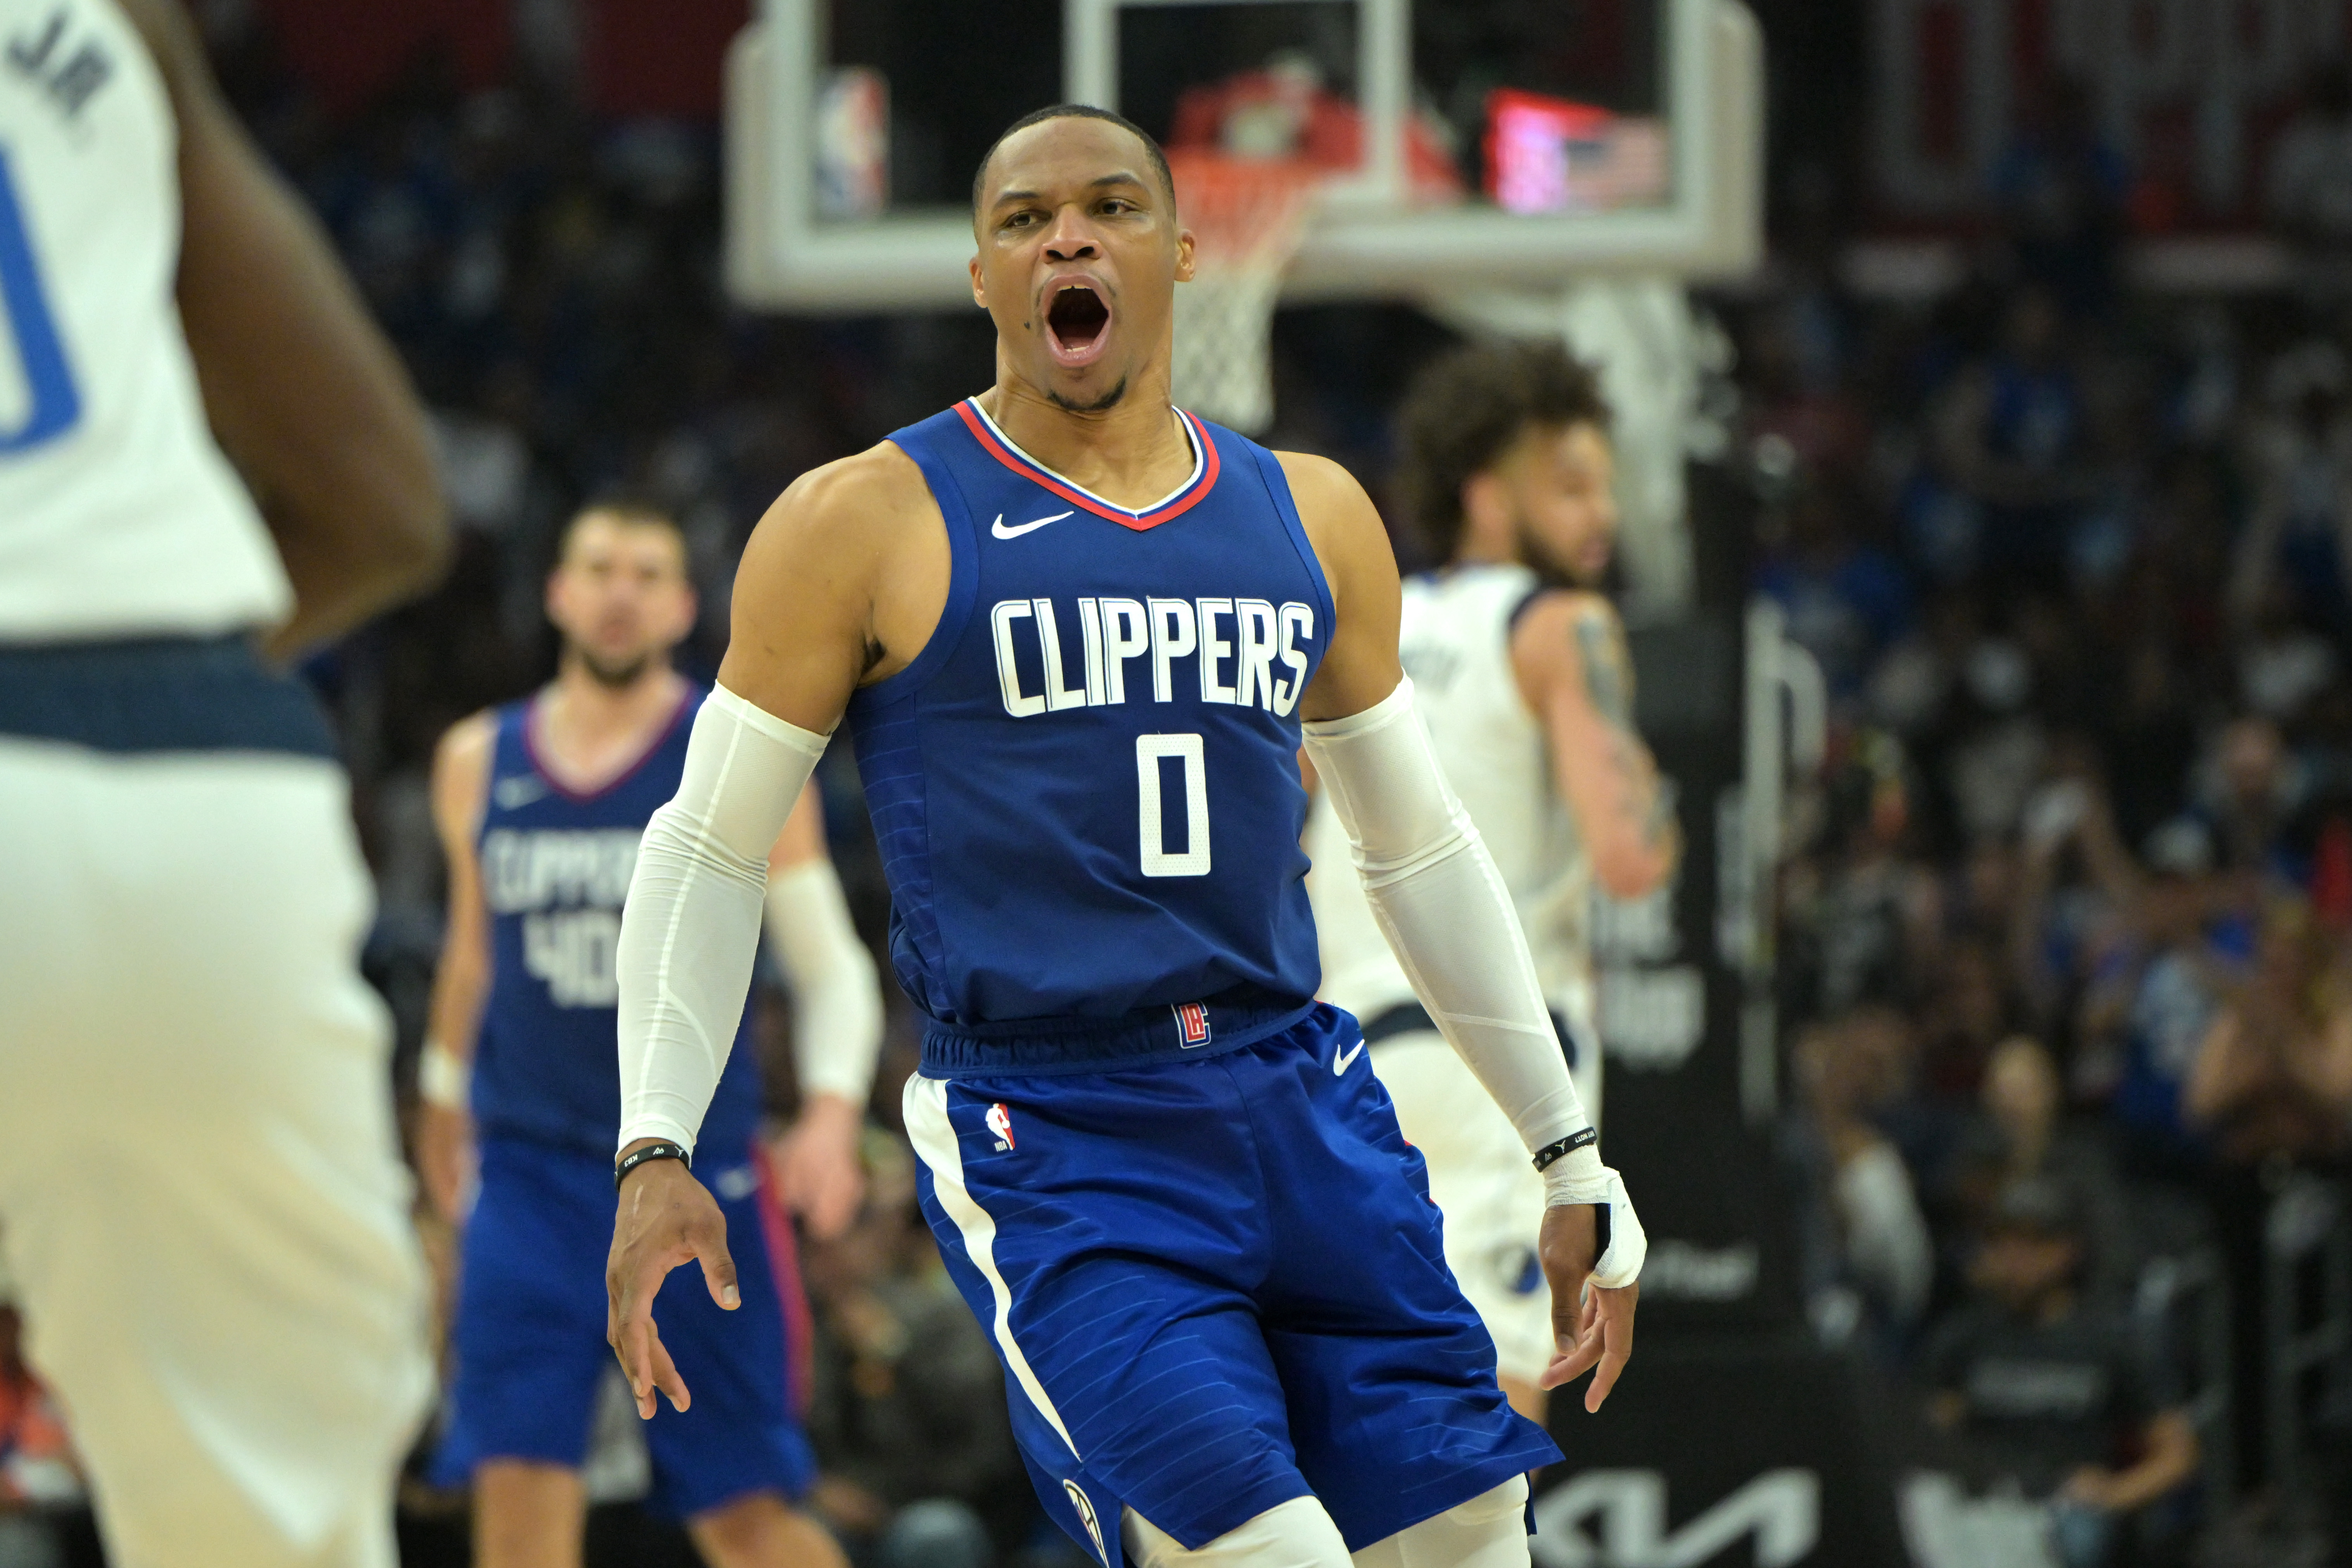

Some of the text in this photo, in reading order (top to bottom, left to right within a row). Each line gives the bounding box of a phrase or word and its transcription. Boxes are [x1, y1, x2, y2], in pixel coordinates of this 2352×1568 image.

[990, 597, 1314, 717] CLIPPERS
[1136, 733, 1211, 877] 0
[1574, 1133, 1588, 1143] NOT?
[994, 1140, 1008, 1152] NBA
[624, 1154, 638, 1167] KB3
